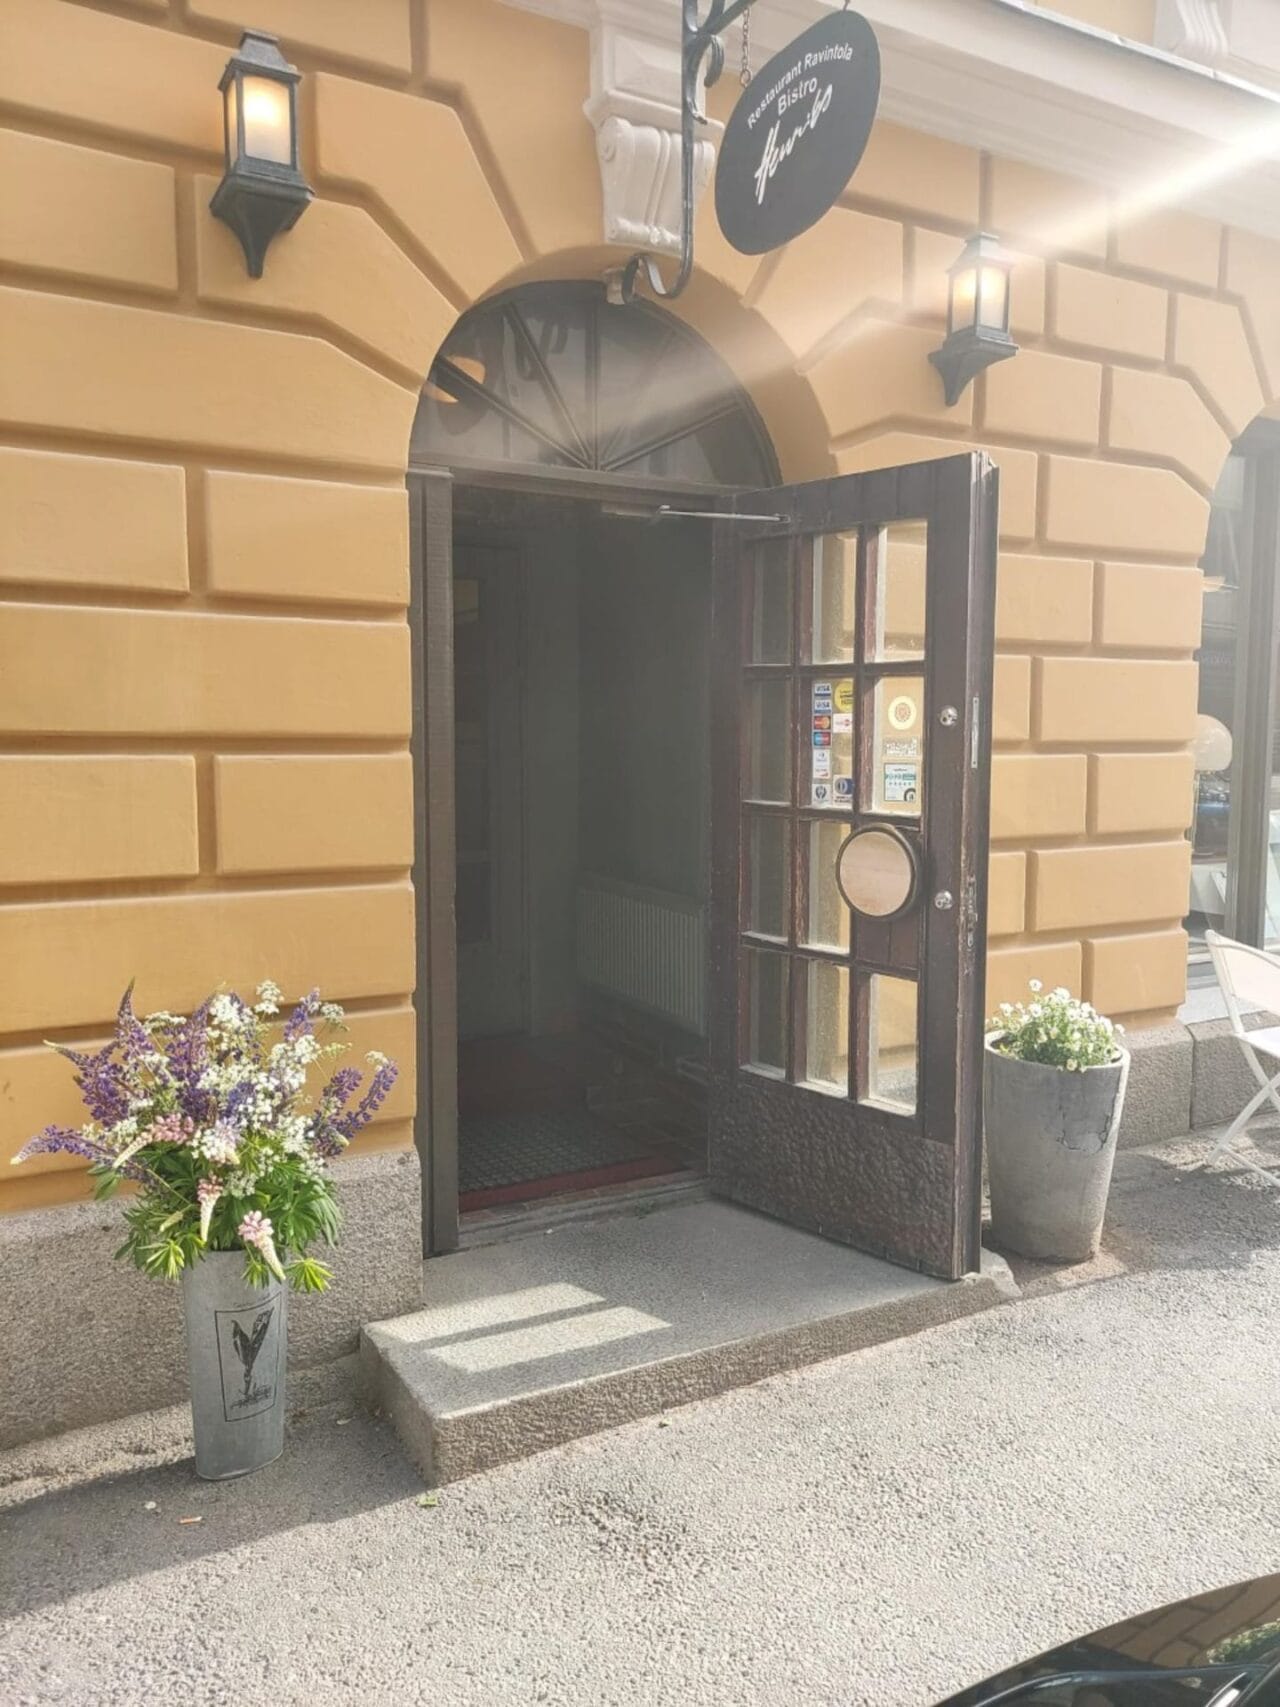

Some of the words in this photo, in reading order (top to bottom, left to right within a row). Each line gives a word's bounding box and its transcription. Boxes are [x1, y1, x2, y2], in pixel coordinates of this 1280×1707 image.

[748, 61, 802, 130] Restaurant
[804, 43, 853, 70] Ravintola
[778, 77, 818, 116] Bistro
